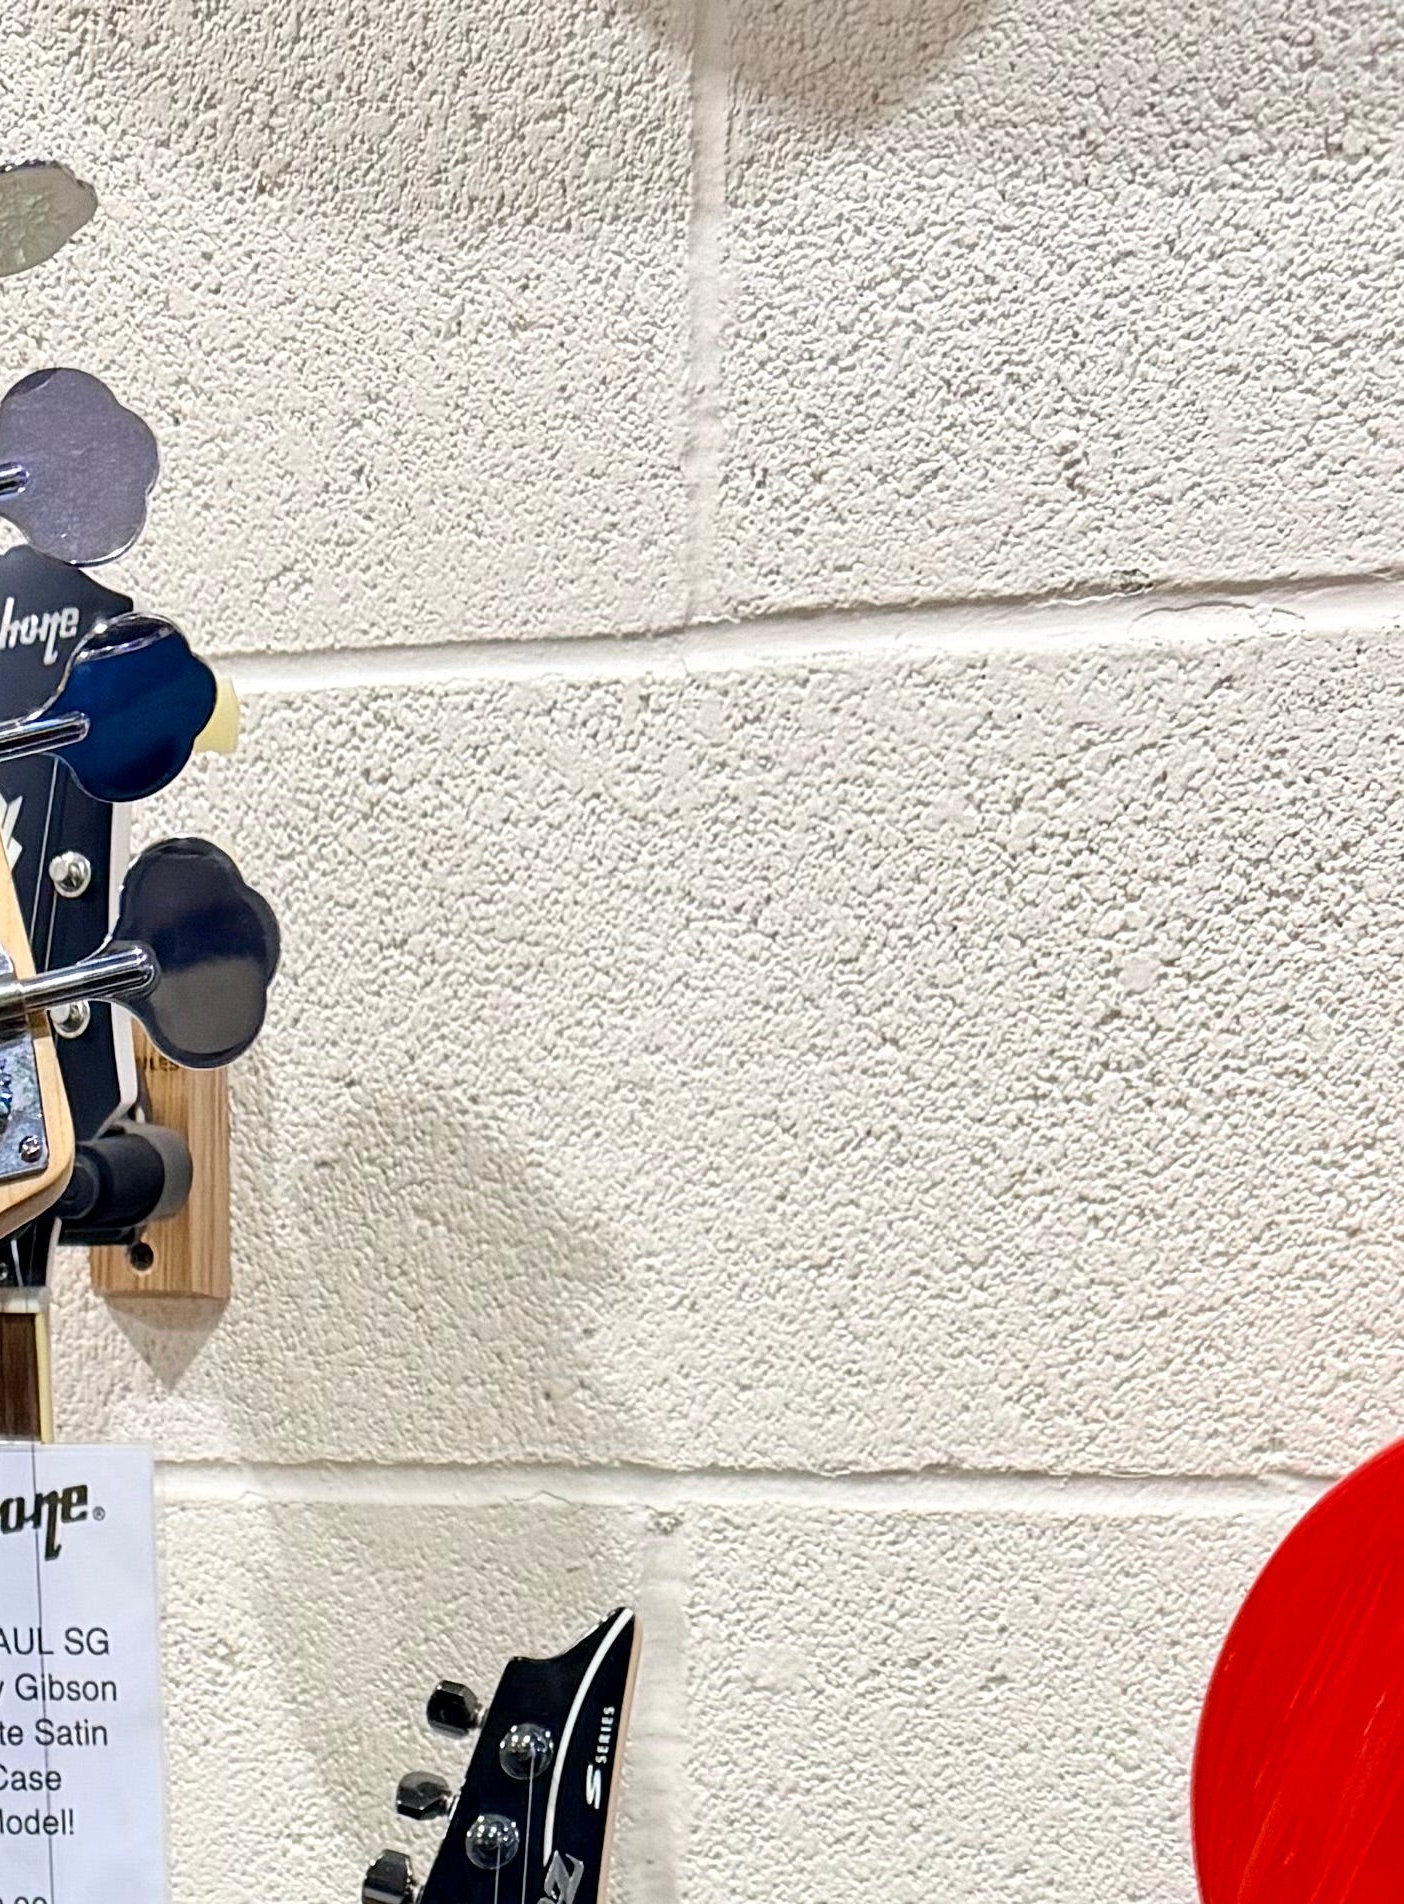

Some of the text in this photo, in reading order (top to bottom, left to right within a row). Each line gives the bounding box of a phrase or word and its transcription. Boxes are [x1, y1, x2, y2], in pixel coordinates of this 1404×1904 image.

[64, 1628, 110, 1656] SG
[15, 1672, 118, 1702] Gibson
[35, 1717, 109, 1747] Satin
[586, 1706, 615, 1810] S SERIES
